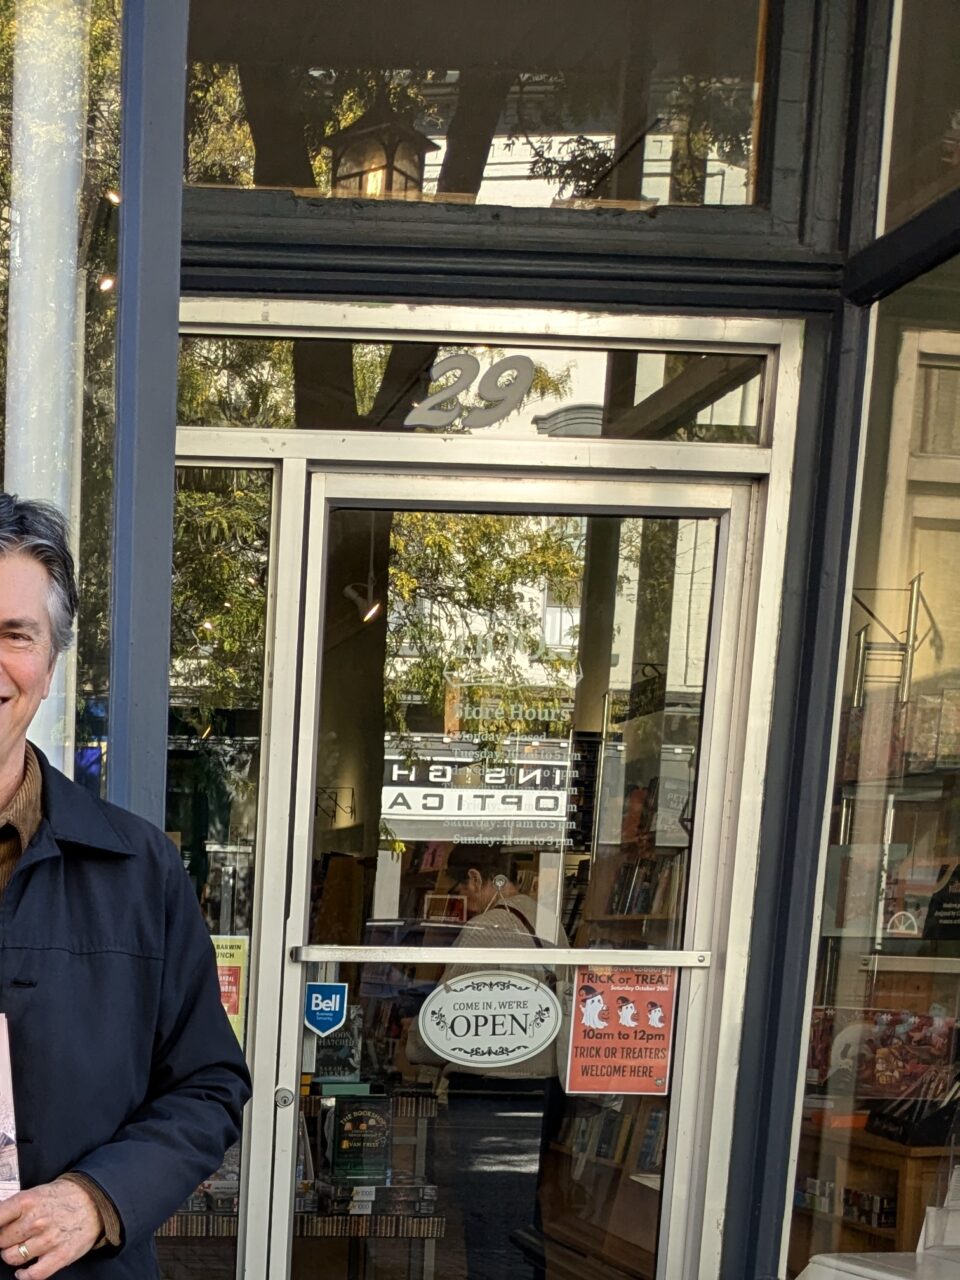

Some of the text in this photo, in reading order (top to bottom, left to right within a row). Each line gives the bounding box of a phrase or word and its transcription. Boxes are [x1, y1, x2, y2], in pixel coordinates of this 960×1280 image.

[403, 354, 535, 429] 29
[509, 703, 571, 722] Hours
[442, 817, 500, 834] Saturday:
[535, 819, 548, 830] to
[558, 820, 577, 833] pm
[452, 833, 500, 848] Sunday:
[580, 972, 672, 985] TRICK or TREAT
[311, 993, 340, 1012] Bell
[452, 1002, 480, 1011] COME
[498, 1000, 529, 1010] WE'RE
[449, 1013, 530, 1038] OPEN
[583, 1029, 665, 1043] 10am to 12pm
[573, 1046, 667, 1060] TRICK OR TREATERS
[581, 1064, 654, 1078] WELCOME HERE
